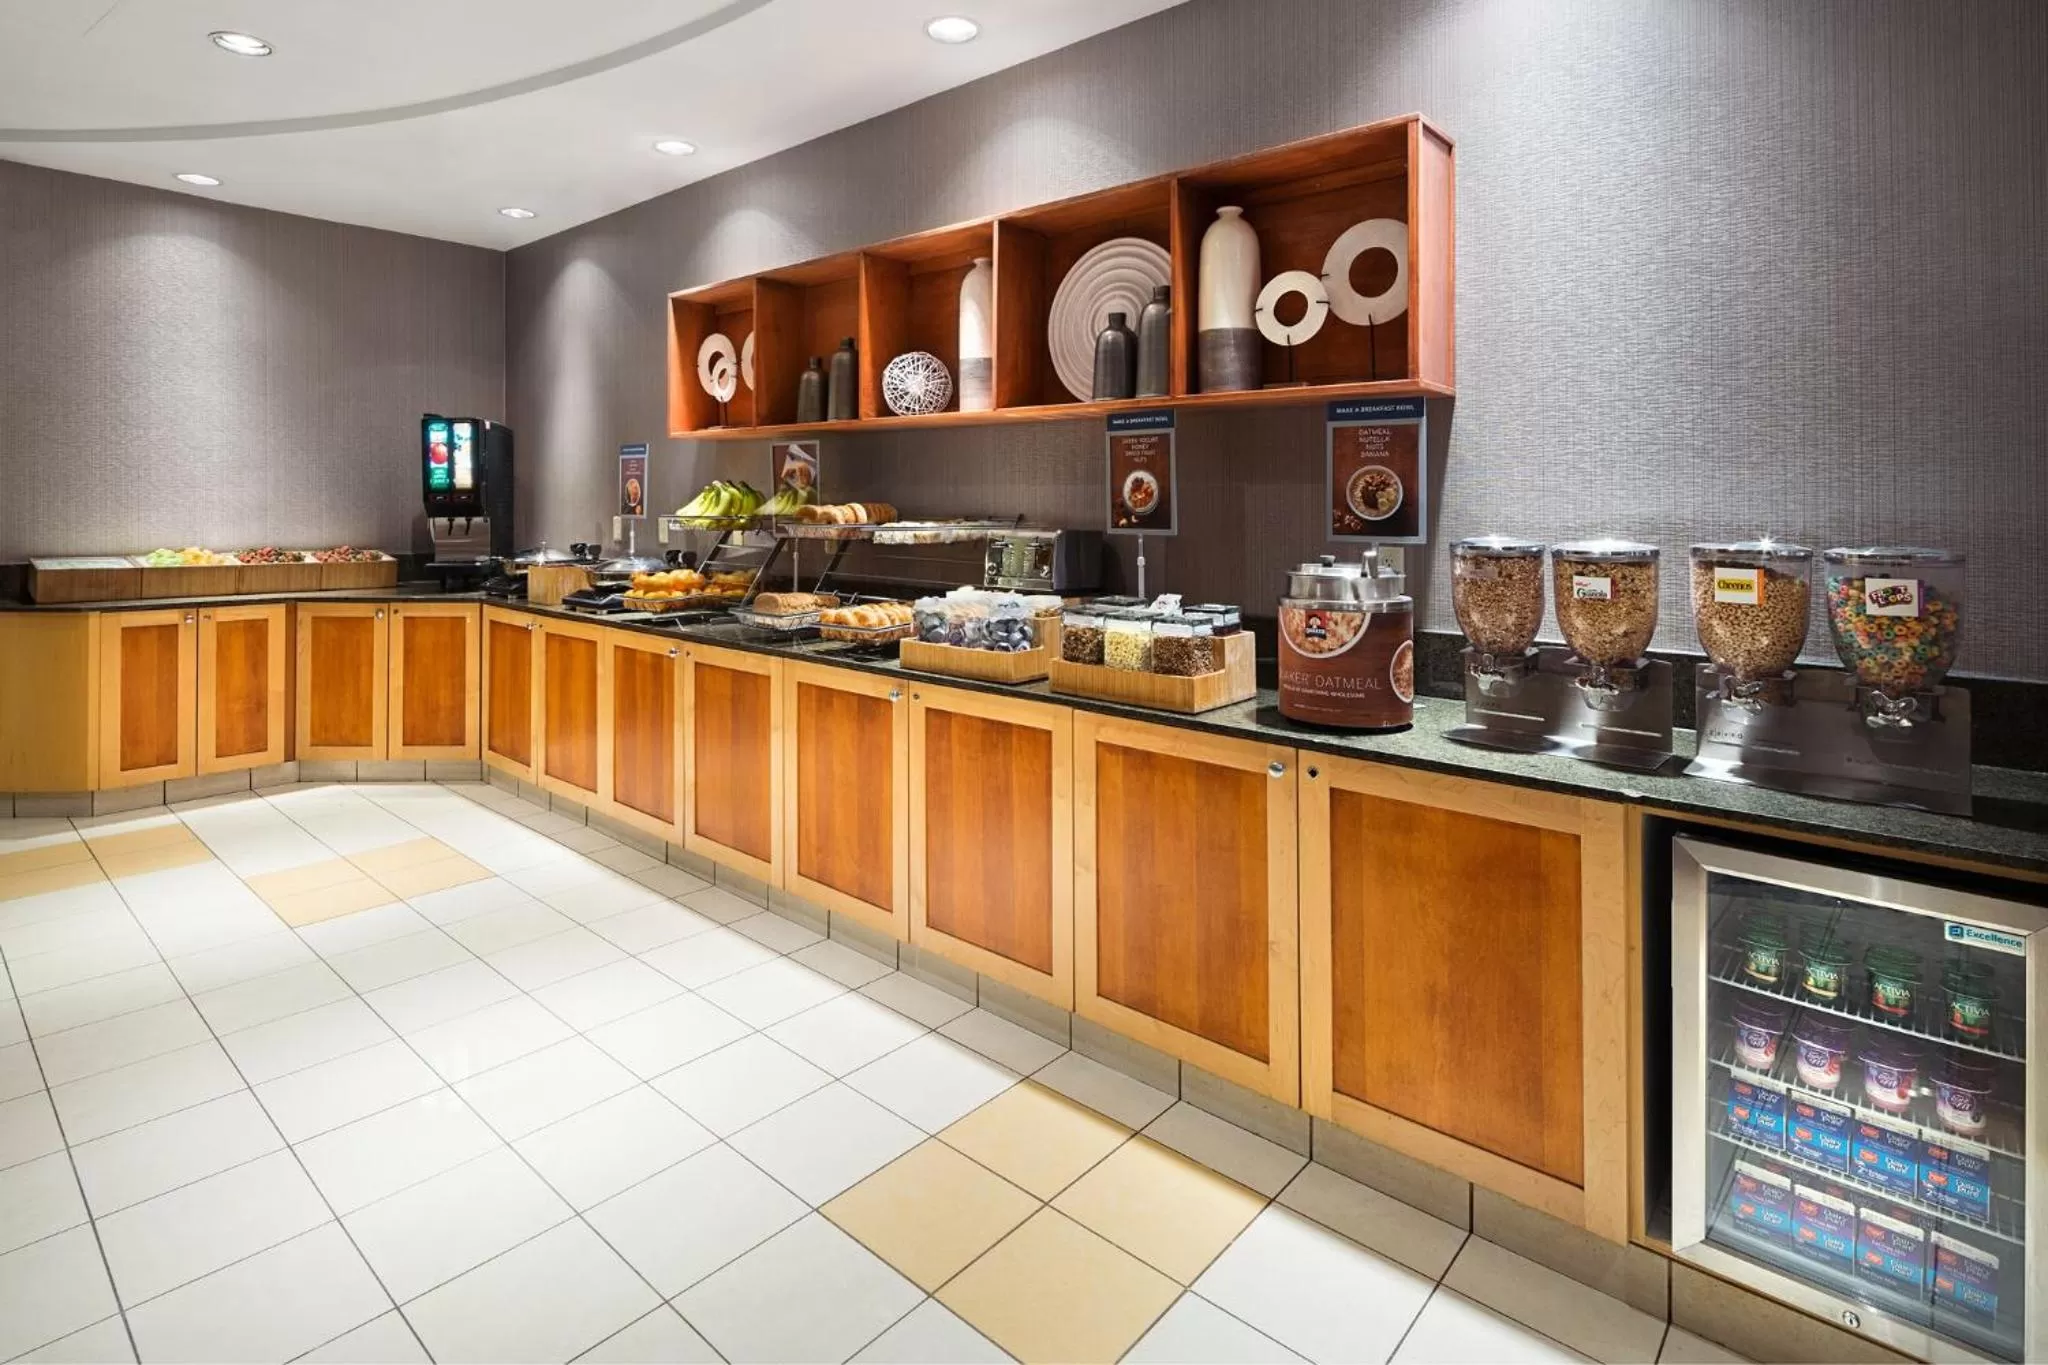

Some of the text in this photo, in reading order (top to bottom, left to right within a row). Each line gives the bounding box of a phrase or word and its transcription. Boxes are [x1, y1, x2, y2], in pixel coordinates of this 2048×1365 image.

[1361, 405, 1395, 413] BREAKFAST
[1358, 427, 1391, 435] OATMEAL
[1360, 450, 1389, 458] BANANA
[1315, 674, 1382, 690] OATMEAL
[1966, 928, 2023, 947] Excellence
[1873, 981, 1911, 998] ACTIVIA
[1951, 1001, 1990, 1017] ACTIVIA
